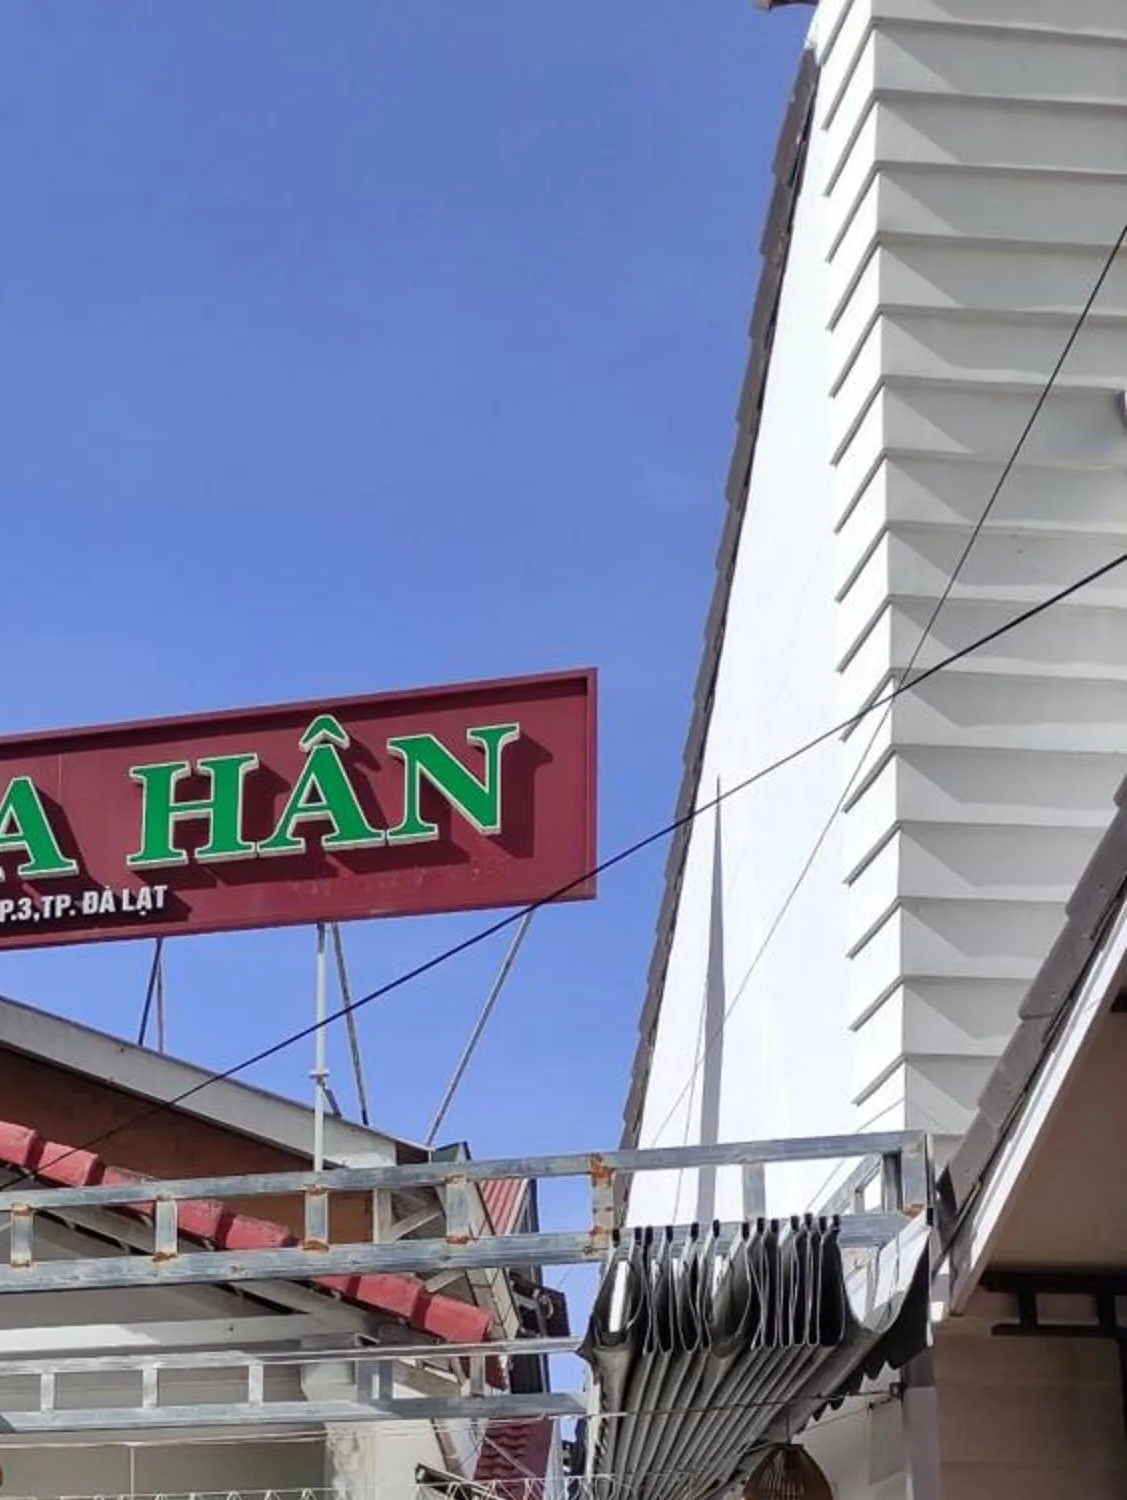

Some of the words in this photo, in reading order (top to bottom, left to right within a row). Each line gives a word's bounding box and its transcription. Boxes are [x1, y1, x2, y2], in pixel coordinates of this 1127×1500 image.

[126, 715, 520, 871] HÂN
[82, 886, 116, 915] ĐÀ
[122, 885, 169, 917] LẠT
